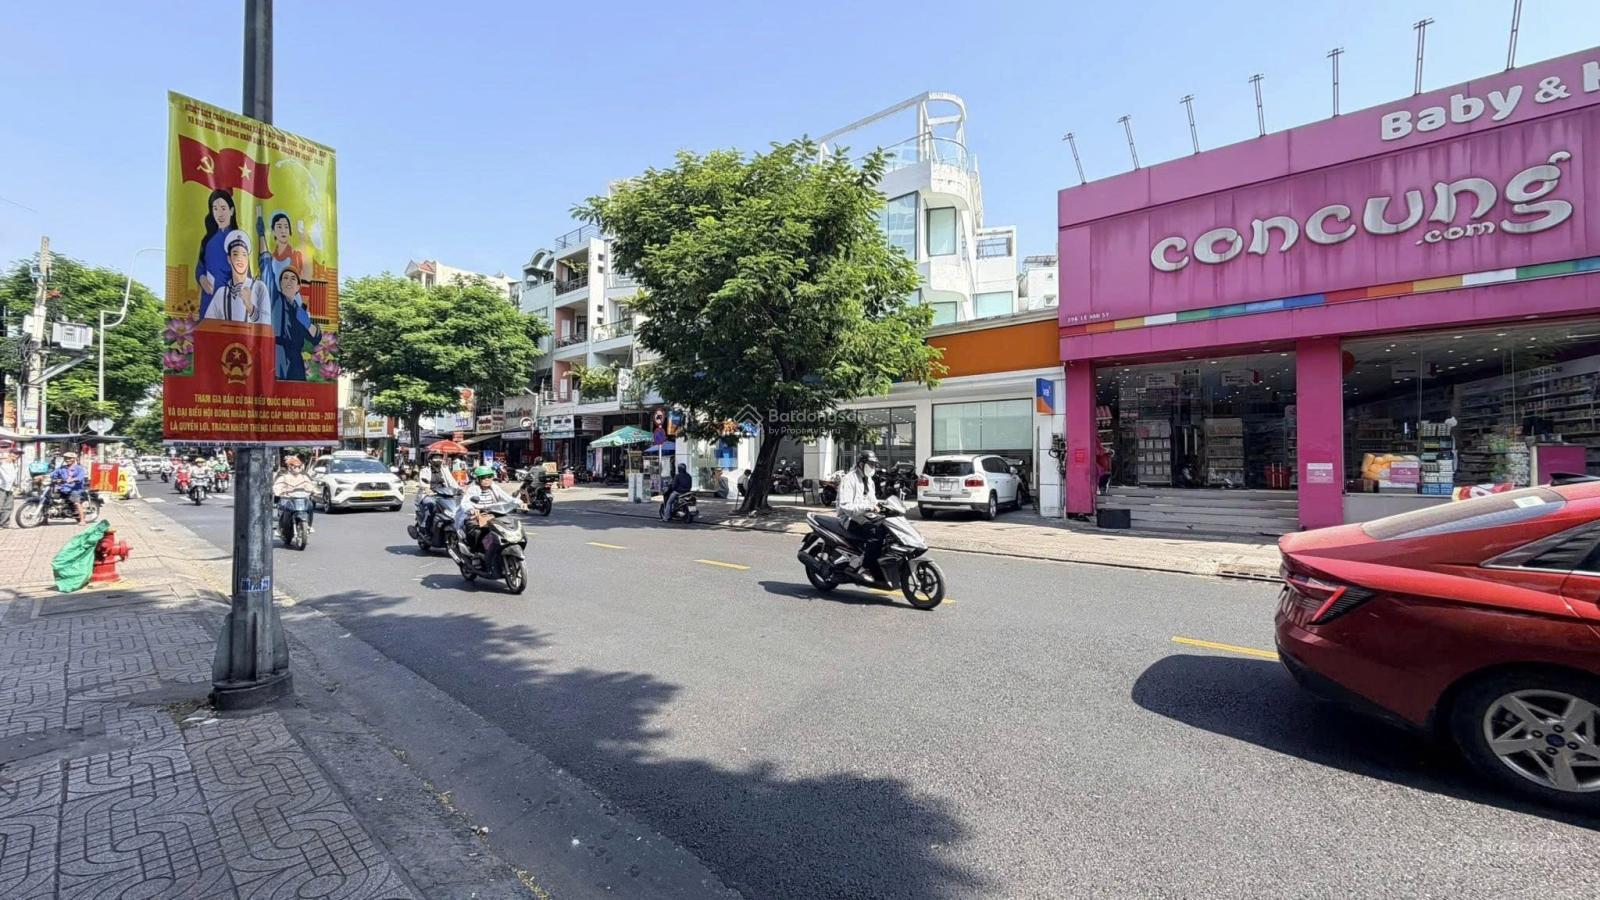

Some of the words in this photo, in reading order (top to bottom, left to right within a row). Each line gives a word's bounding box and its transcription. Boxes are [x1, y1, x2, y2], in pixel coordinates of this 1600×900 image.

[1381, 85, 1523, 141] Baby
[1534, 76, 1571, 103] &
[1150, 150, 1574, 273] concung
[1415, 219, 1496, 246] .com
